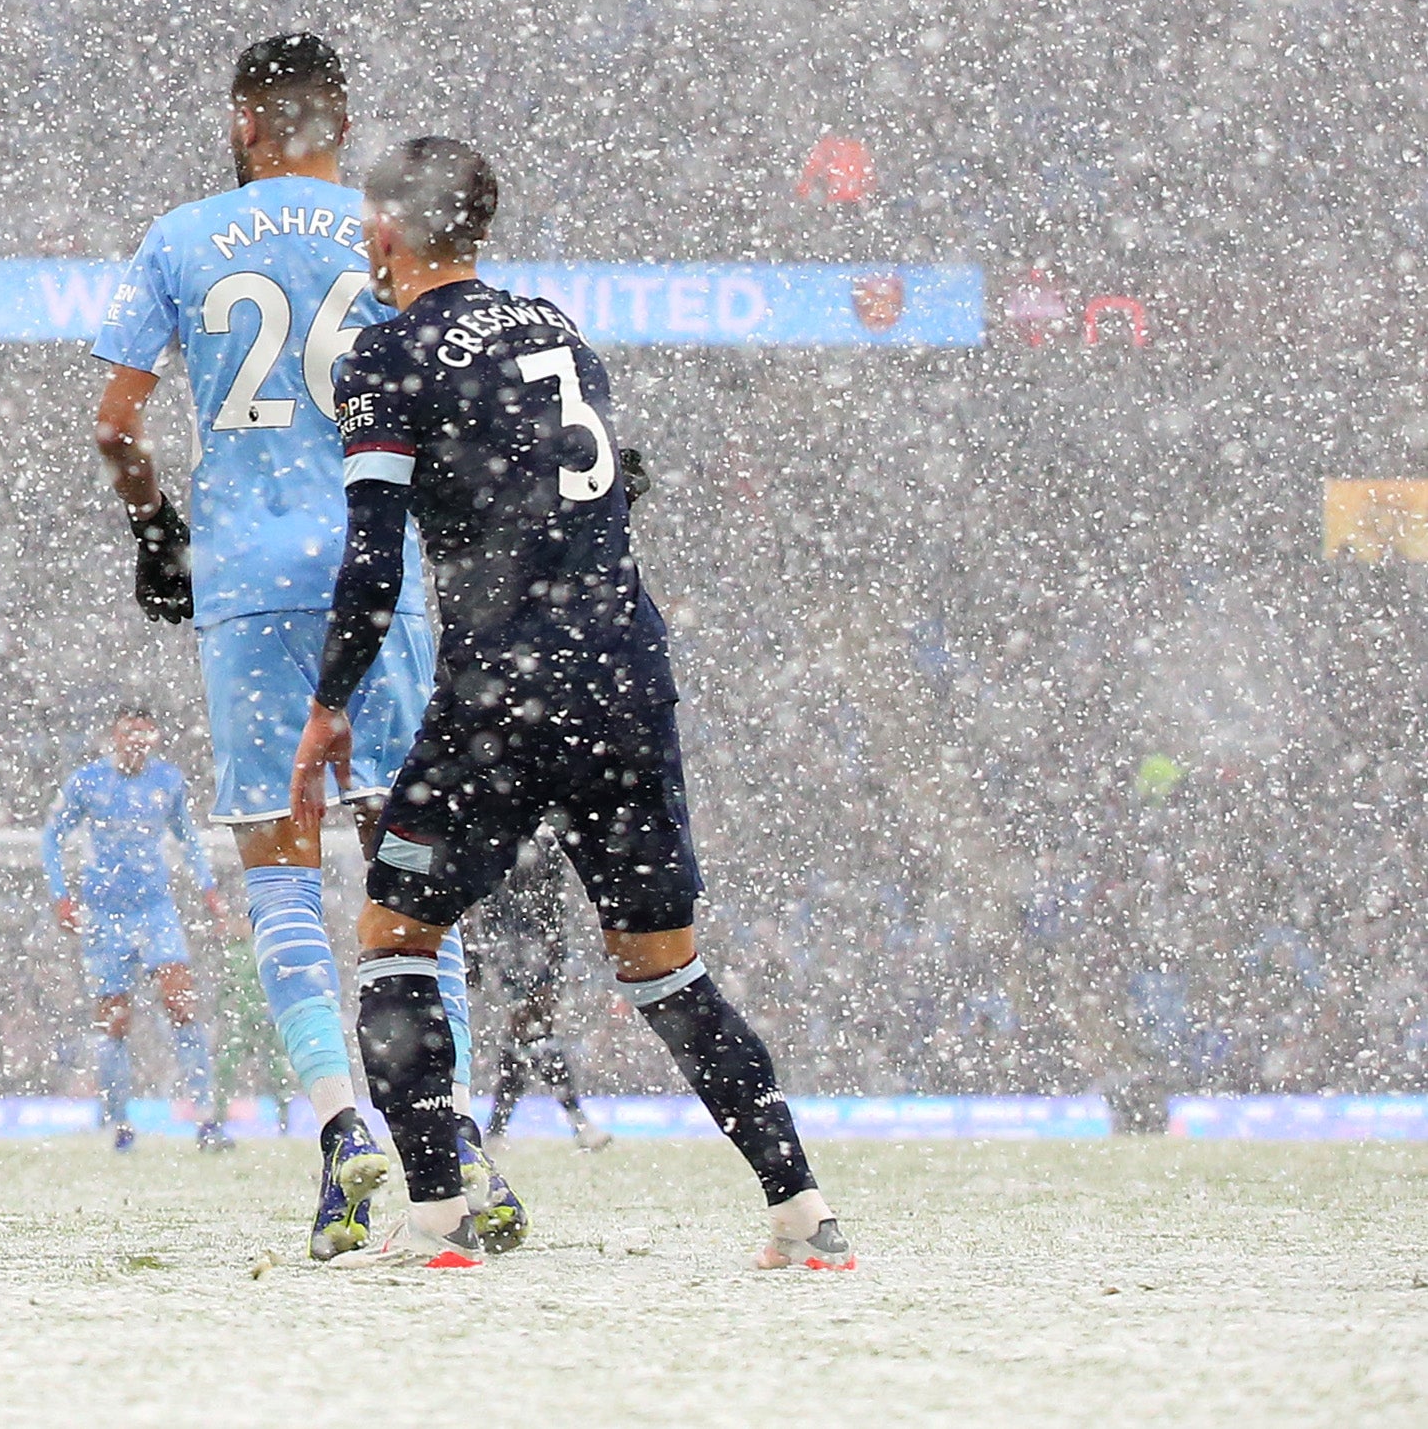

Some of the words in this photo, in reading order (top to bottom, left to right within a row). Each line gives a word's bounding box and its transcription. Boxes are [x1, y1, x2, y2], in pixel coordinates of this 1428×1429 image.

[202, 270, 371, 431] 26
[493, 274, 768, 333] NITED
[515, 345, 616, 502] 3
